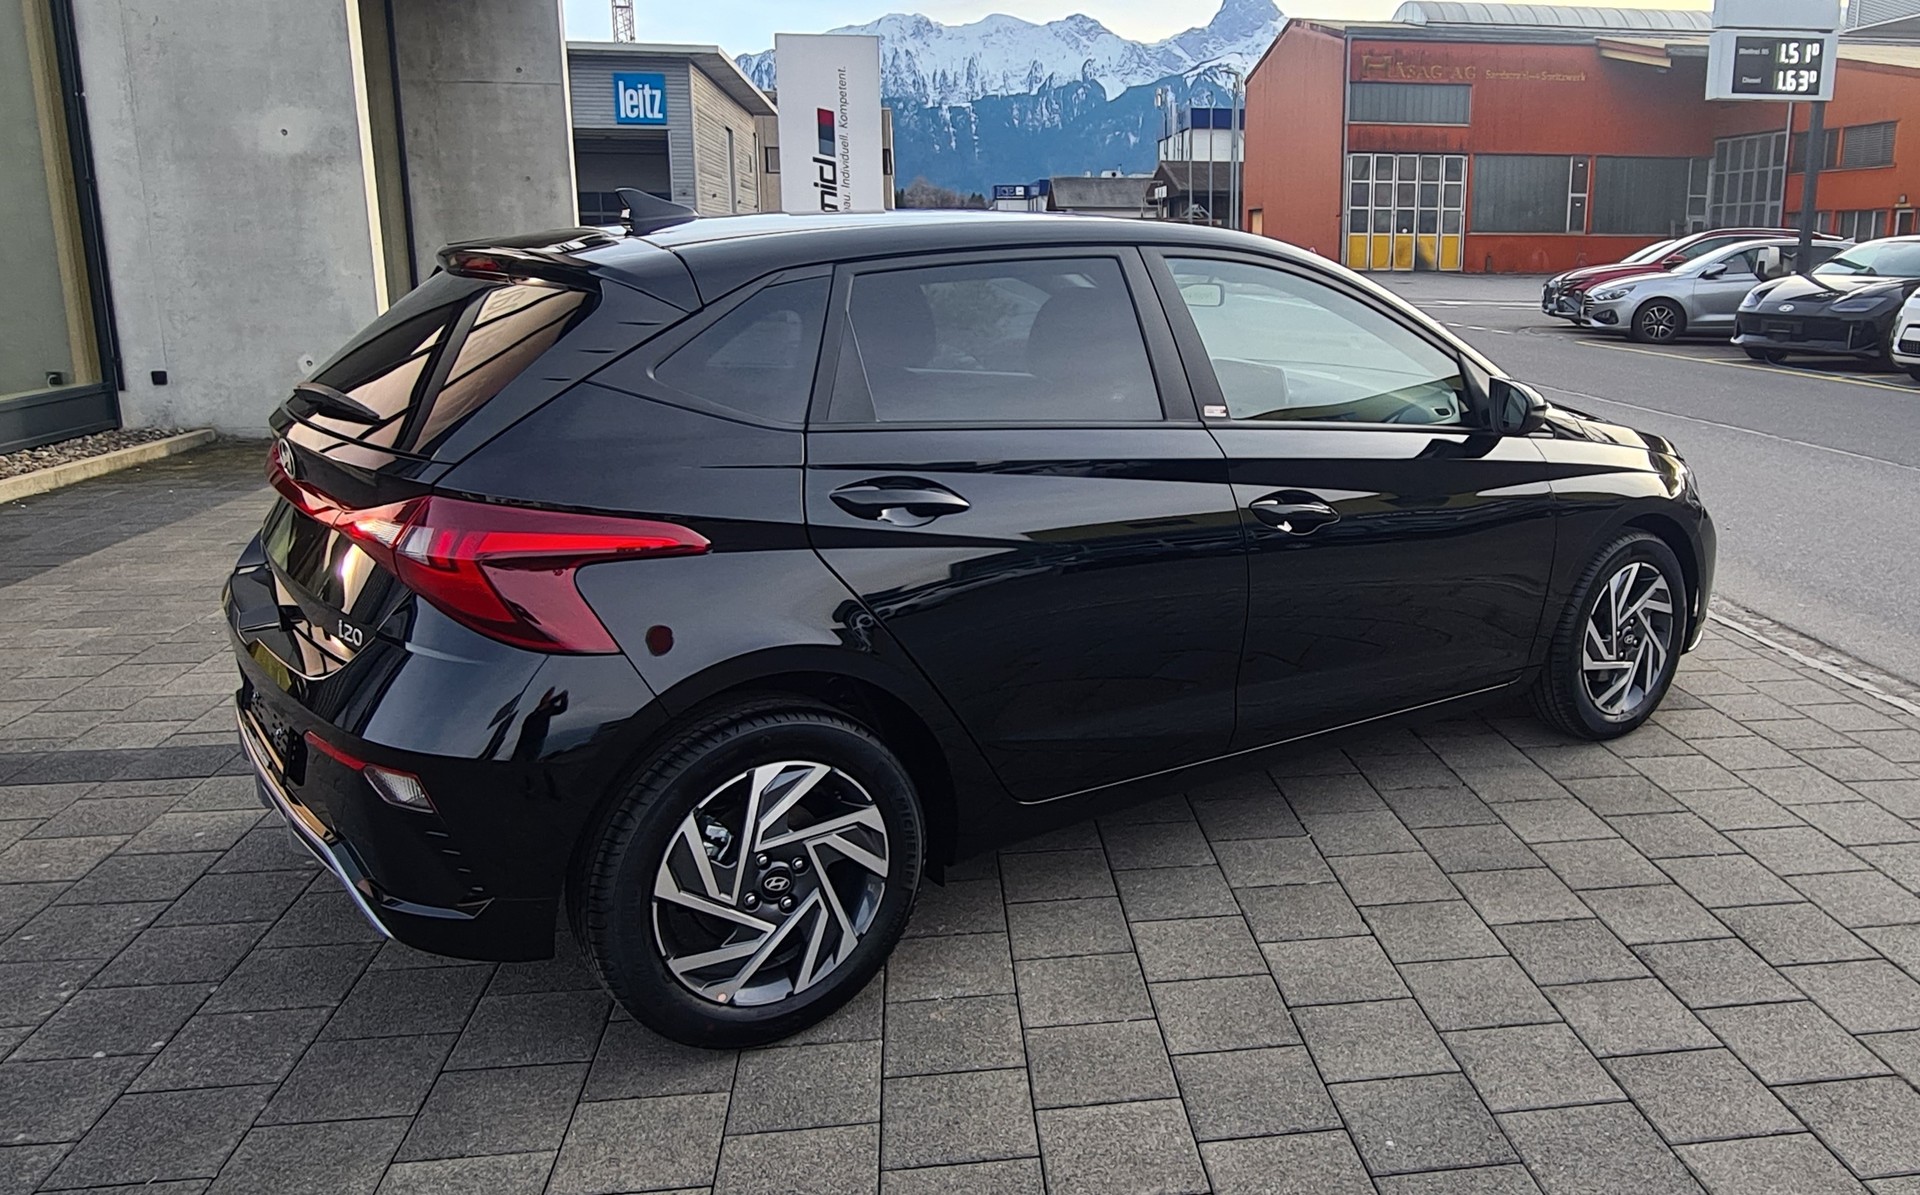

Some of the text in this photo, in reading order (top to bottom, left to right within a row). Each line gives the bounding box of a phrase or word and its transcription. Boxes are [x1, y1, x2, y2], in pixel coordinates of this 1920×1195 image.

[1450, 65, 1476, 80] AG
[618, 80, 664, 119] leitz
[838, 65, 849, 129] Kompetent.
[839, 132, 850, 188] Individuell.
